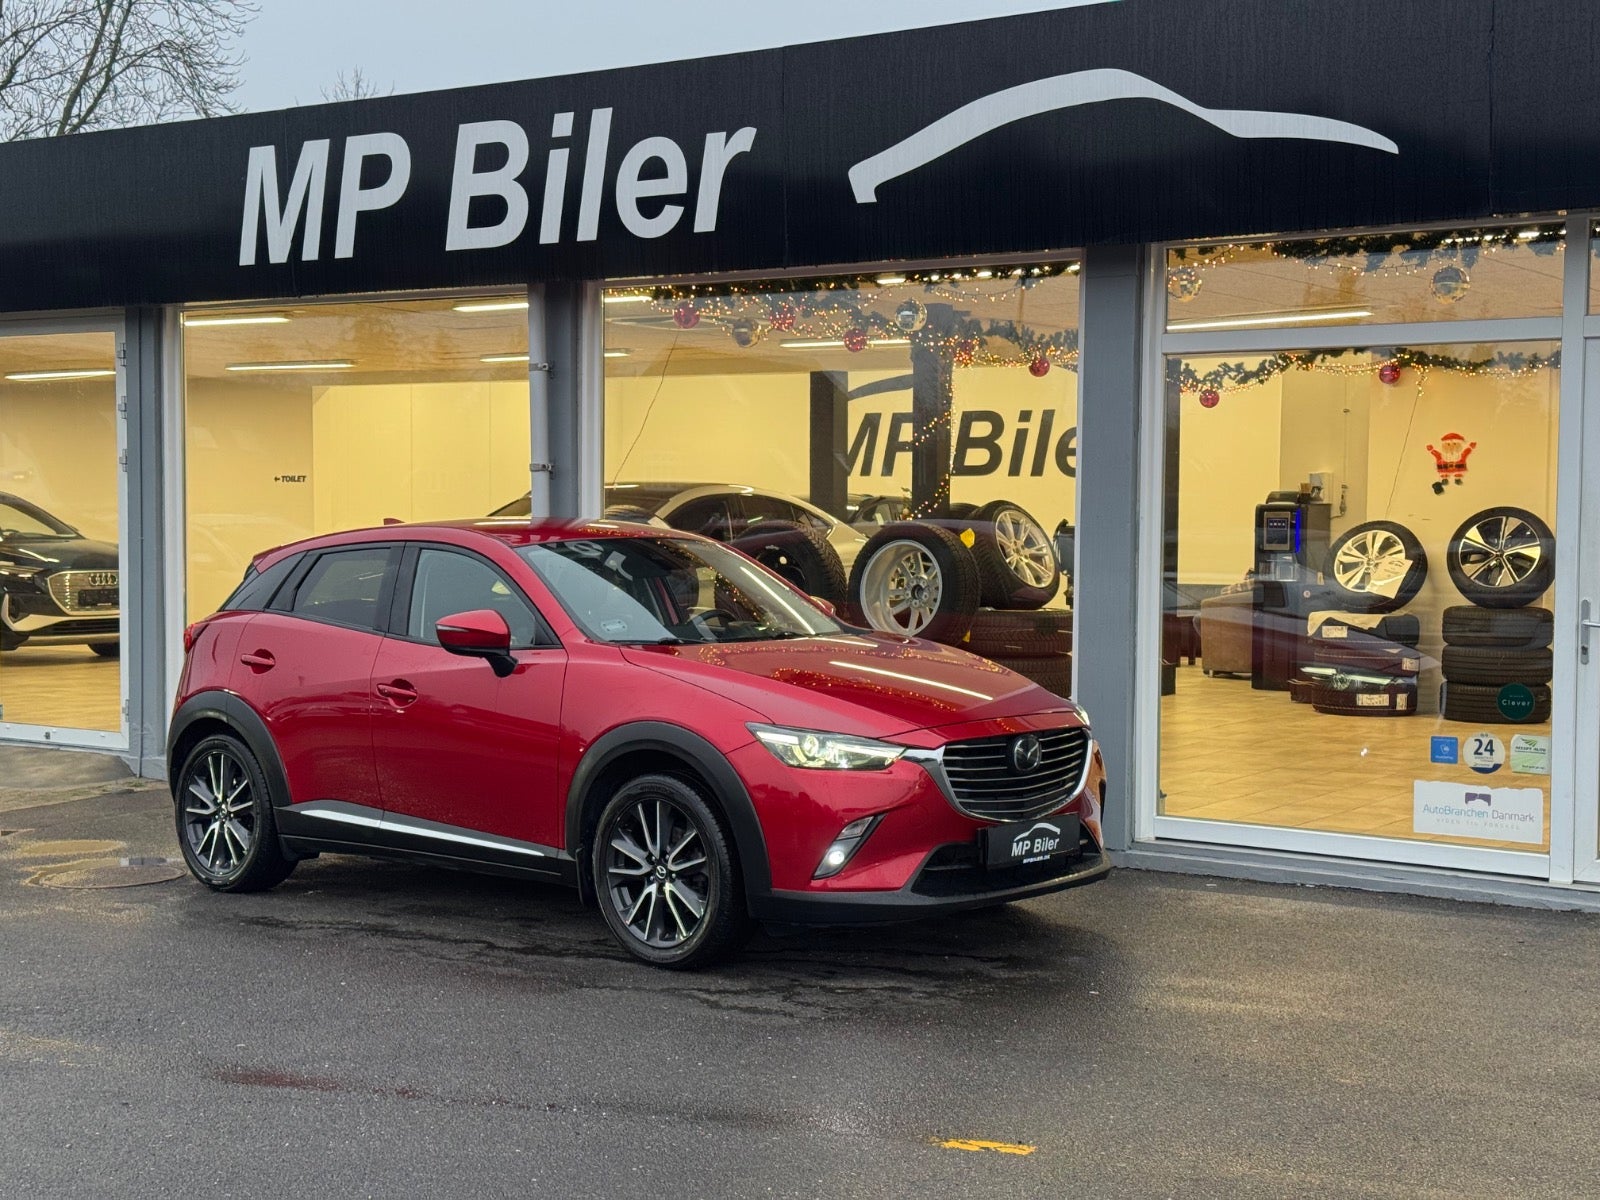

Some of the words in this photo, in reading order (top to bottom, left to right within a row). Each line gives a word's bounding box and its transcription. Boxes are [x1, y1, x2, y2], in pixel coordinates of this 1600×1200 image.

[239, 131, 411, 266] MP
[445, 107, 757, 252] Biler
[281, 475, 306, 483] TOILET
[1501, 699, 1531, 707] Clever
[1473, 738, 1495, 757] 24
[1423, 804, 1489, 819] AutoBranchen
[1491, 809, 1535, 823] Danmark
[1011, 841, 1031, 856] MP
[1033, 837, 1060, 853] Biler
